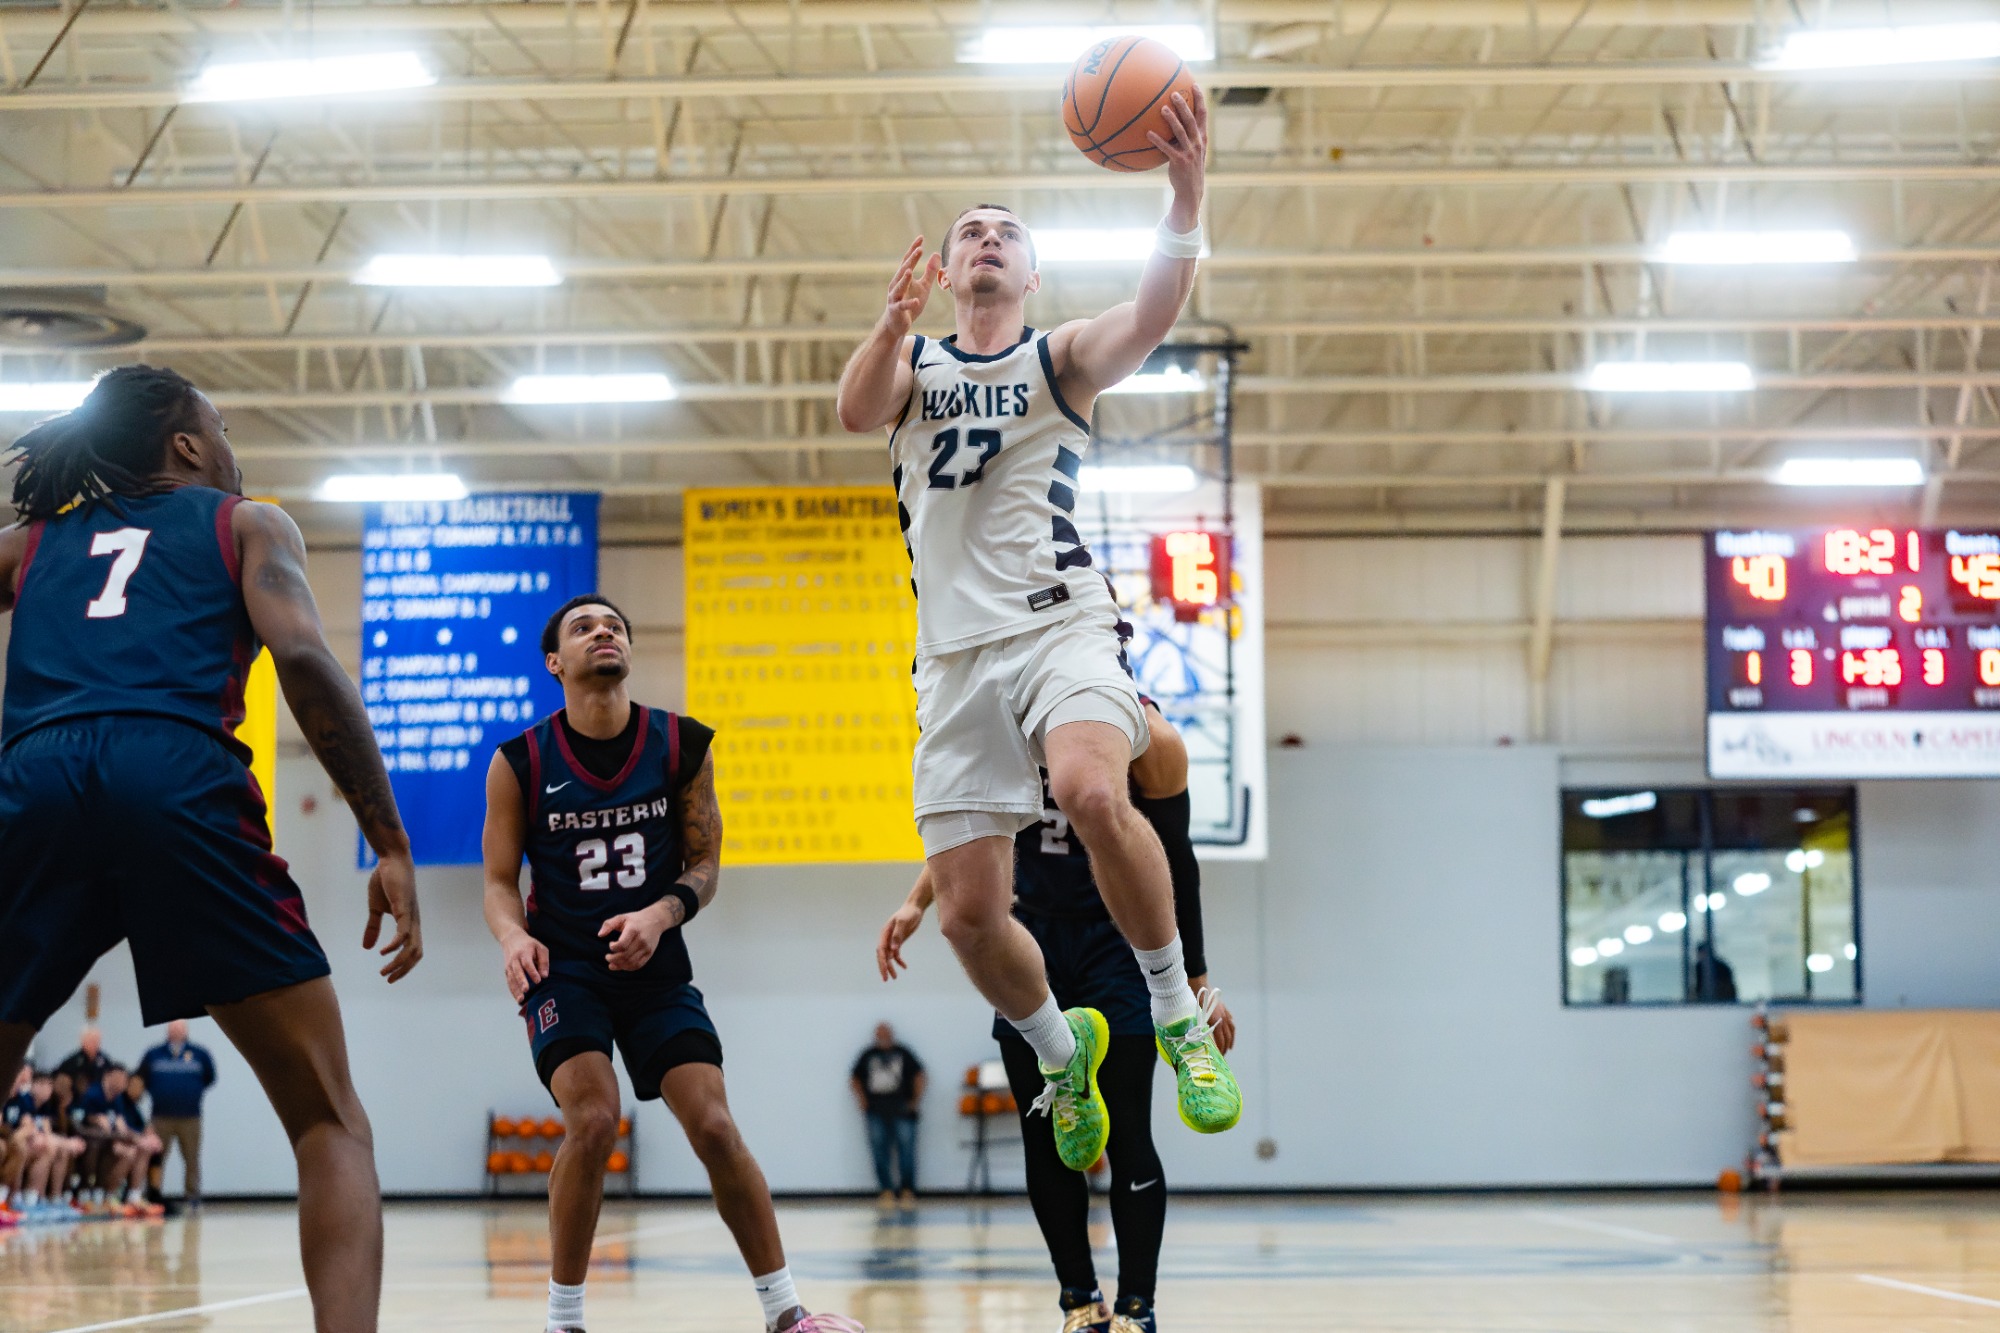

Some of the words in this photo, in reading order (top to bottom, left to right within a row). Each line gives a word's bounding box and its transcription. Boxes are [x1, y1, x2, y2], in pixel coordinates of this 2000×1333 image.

[922, 381, 1029, 421] HUSKIES
[795, 497, 899, 520] BASKETBA
[1824, 529, 1919, 574] 18:21
[86, 527, 152, 618] 7
[1732, 553, 1787, 600] 40
[1951, 552, 2000, 599] 45
[1898, 584, 1923, 622] 2
[1746, 650, 1762, 685] 1
[1790, 649, 1813, 686] 3
[1922, 649, 1945, 686] 3
[1812, 728, 1907, 750] LINCOLN
[548, 797, 668, 832] EASTERN
[1040, 807, 1070, 855] 2
[575, 831, 647, 891] 23
[538, 998, 559, 1034] E
